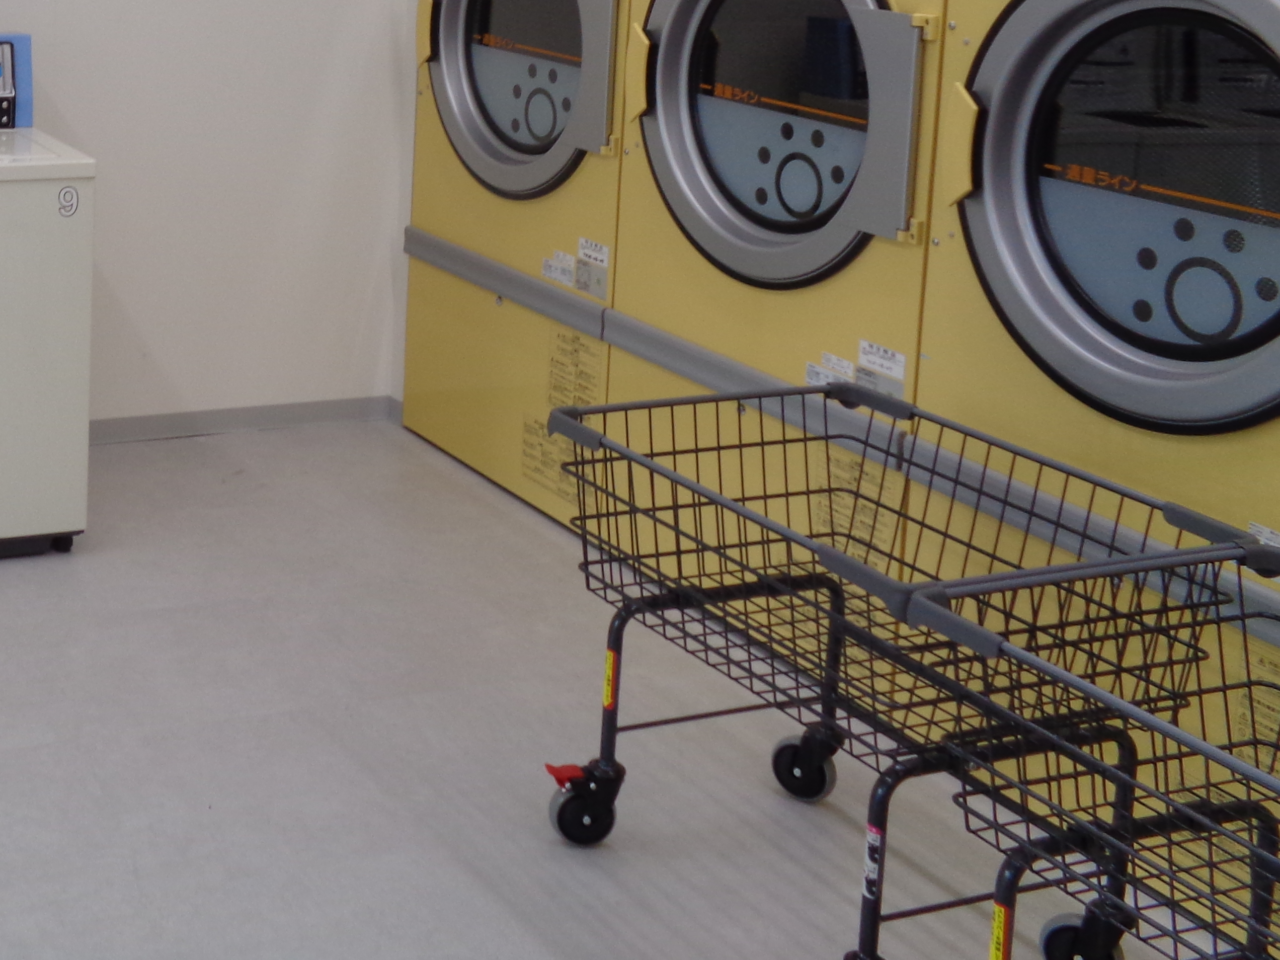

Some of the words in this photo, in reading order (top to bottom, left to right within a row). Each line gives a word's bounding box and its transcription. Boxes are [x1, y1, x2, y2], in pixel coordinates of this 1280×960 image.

[714, 80, 760, 106] 適量ライン
[1065, 163, 1138, 194] 適量ライン
[57, 186, 80, 218] 9
